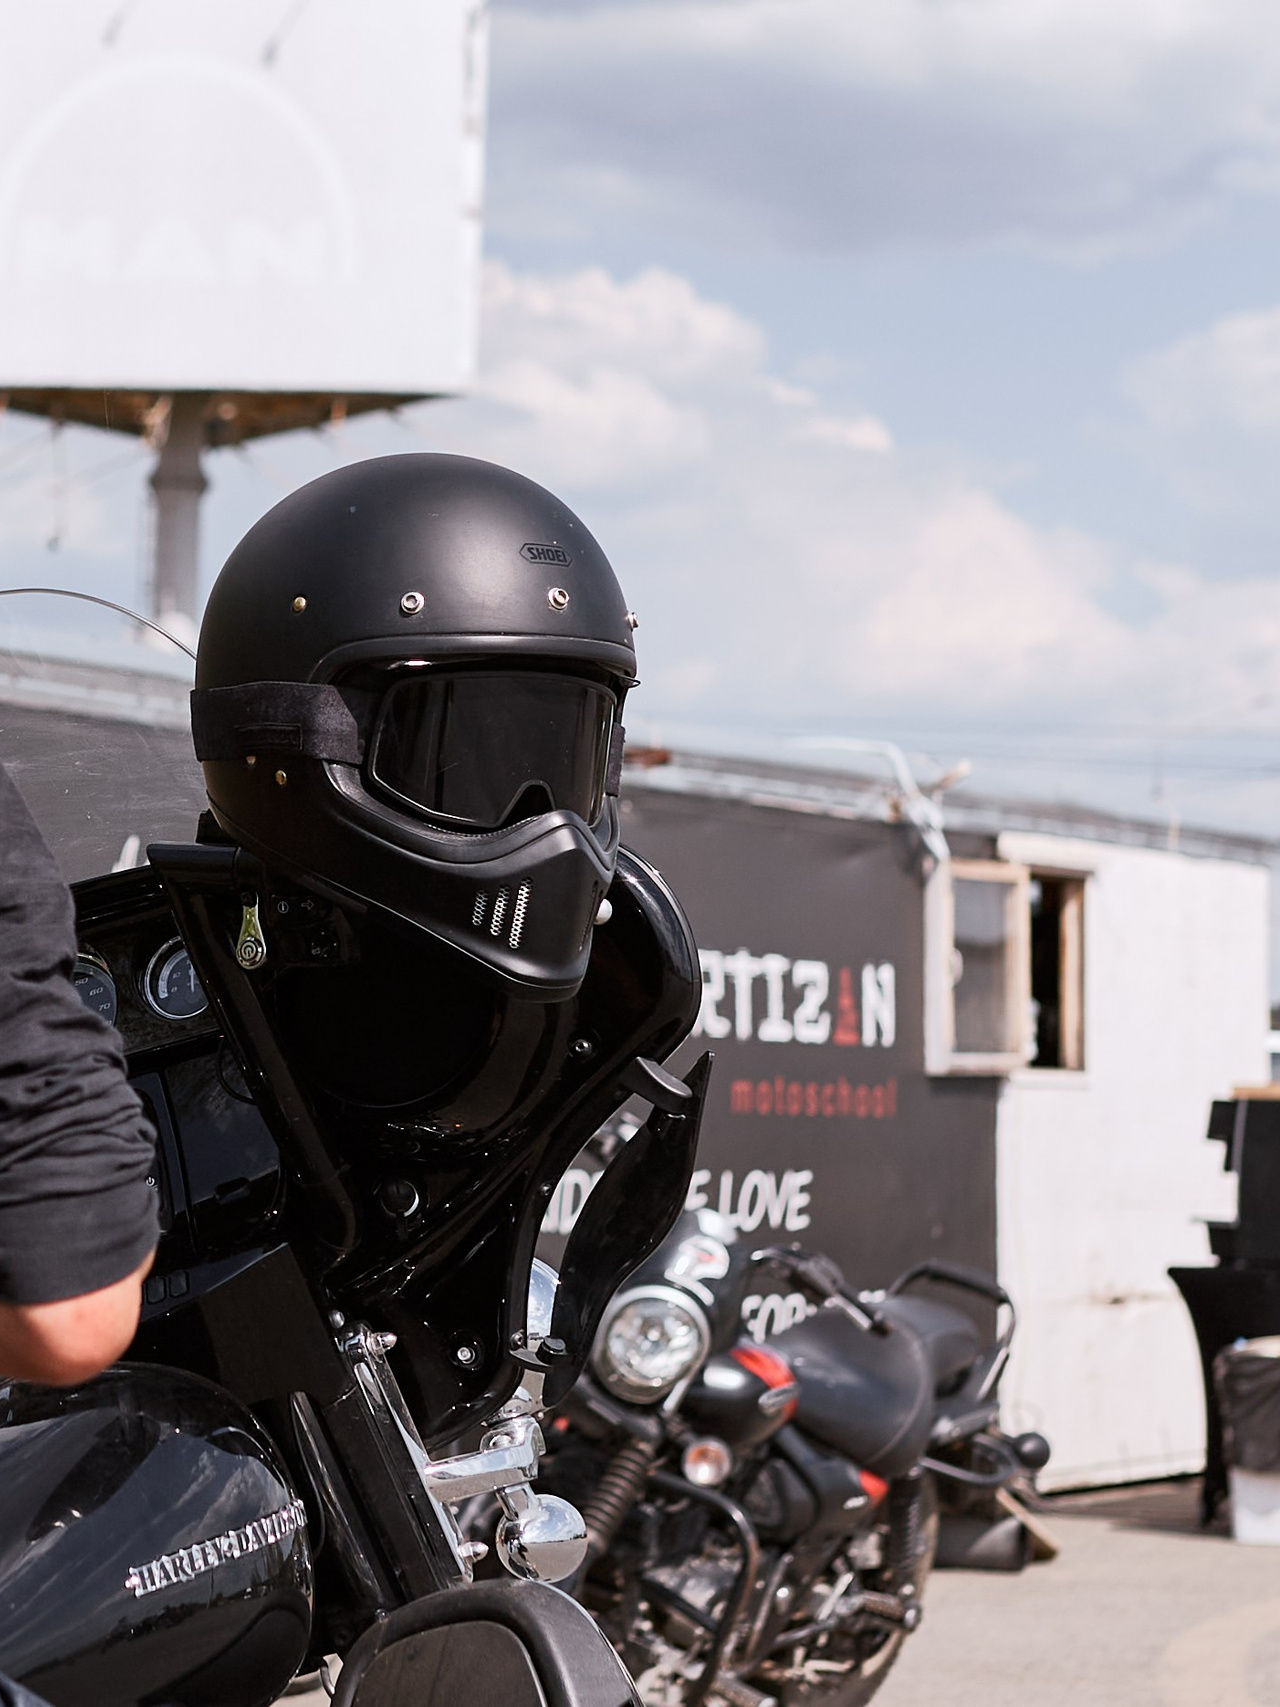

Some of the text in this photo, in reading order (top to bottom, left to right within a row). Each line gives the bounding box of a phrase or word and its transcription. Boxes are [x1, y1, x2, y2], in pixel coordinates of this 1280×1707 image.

[19, 214, 326, 283] MAN
[527, 547, 568, 563] SHOEI
[89, 986, 104, 996] 60
[98, 1002, 111, 1012] 70
[690, 947, 895, 1048] RTIZAN
[730, 1075, 897, 1119] motoschool
[718, 1169, 814, 1232] LOVE
